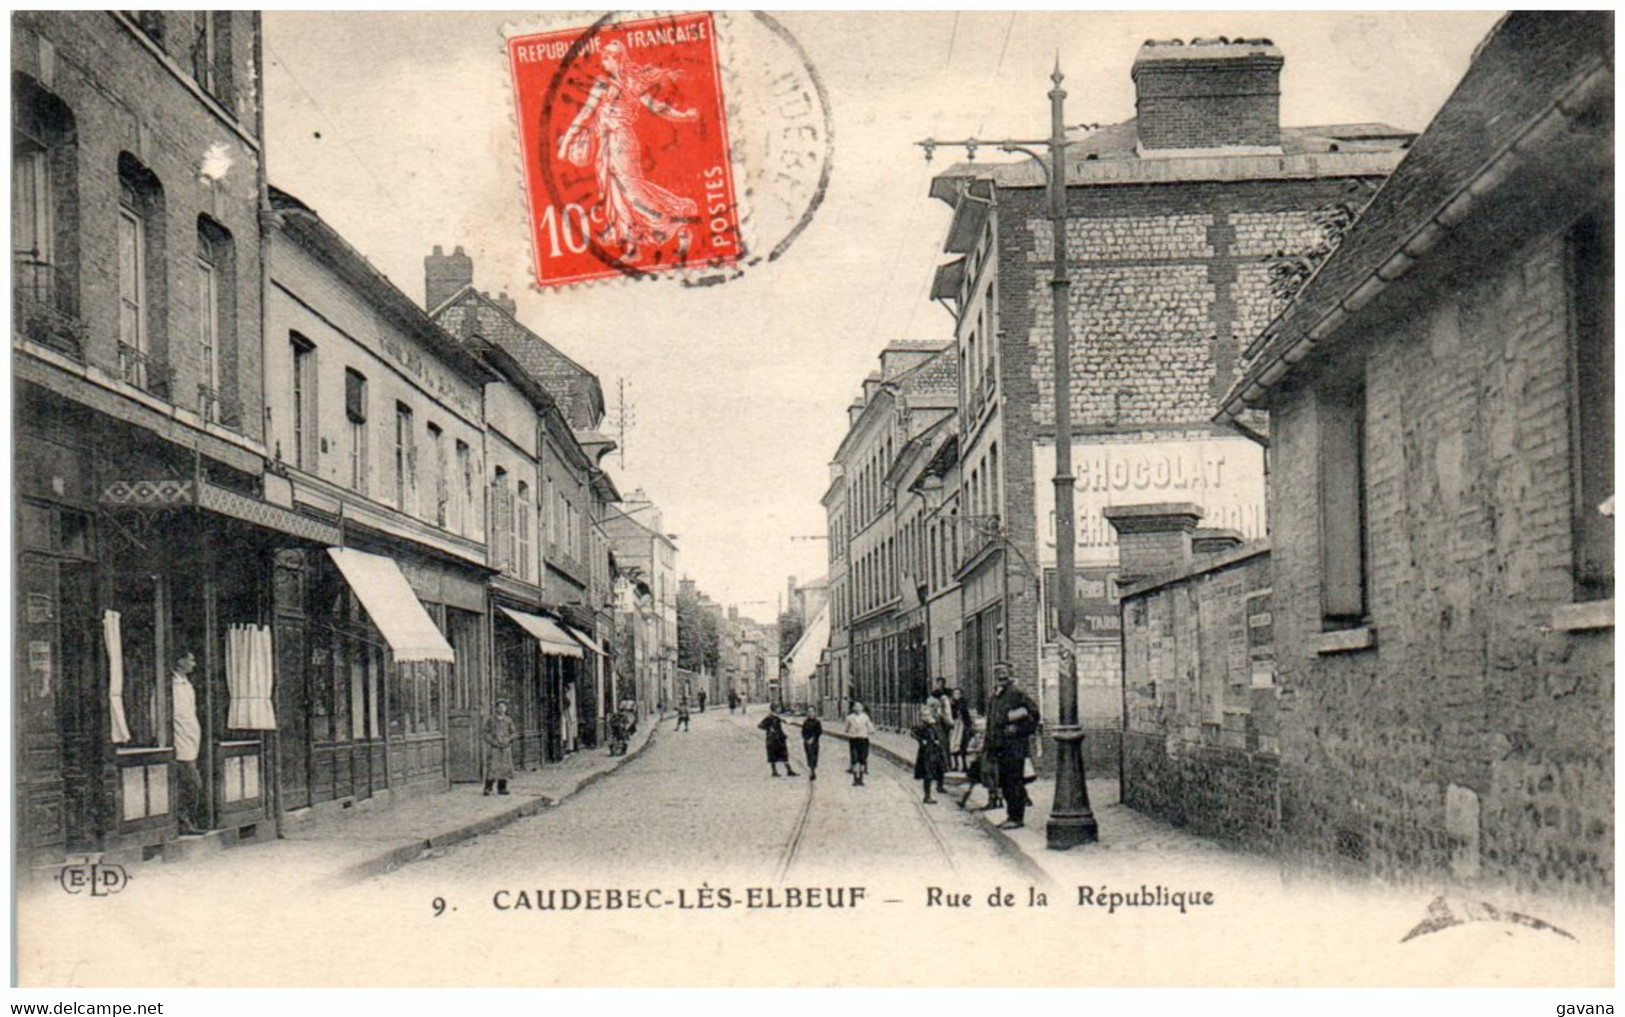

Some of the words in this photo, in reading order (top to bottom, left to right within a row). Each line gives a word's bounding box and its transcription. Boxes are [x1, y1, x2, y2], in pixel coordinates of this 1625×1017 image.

[517, 36, 602, 62] REPUBLQUE
[626, 21, 707, 49] FRANÇAISE
[704, 165, 730, 248] POSTES
[1074, 454, 1225, 493] CHOCOLAT
